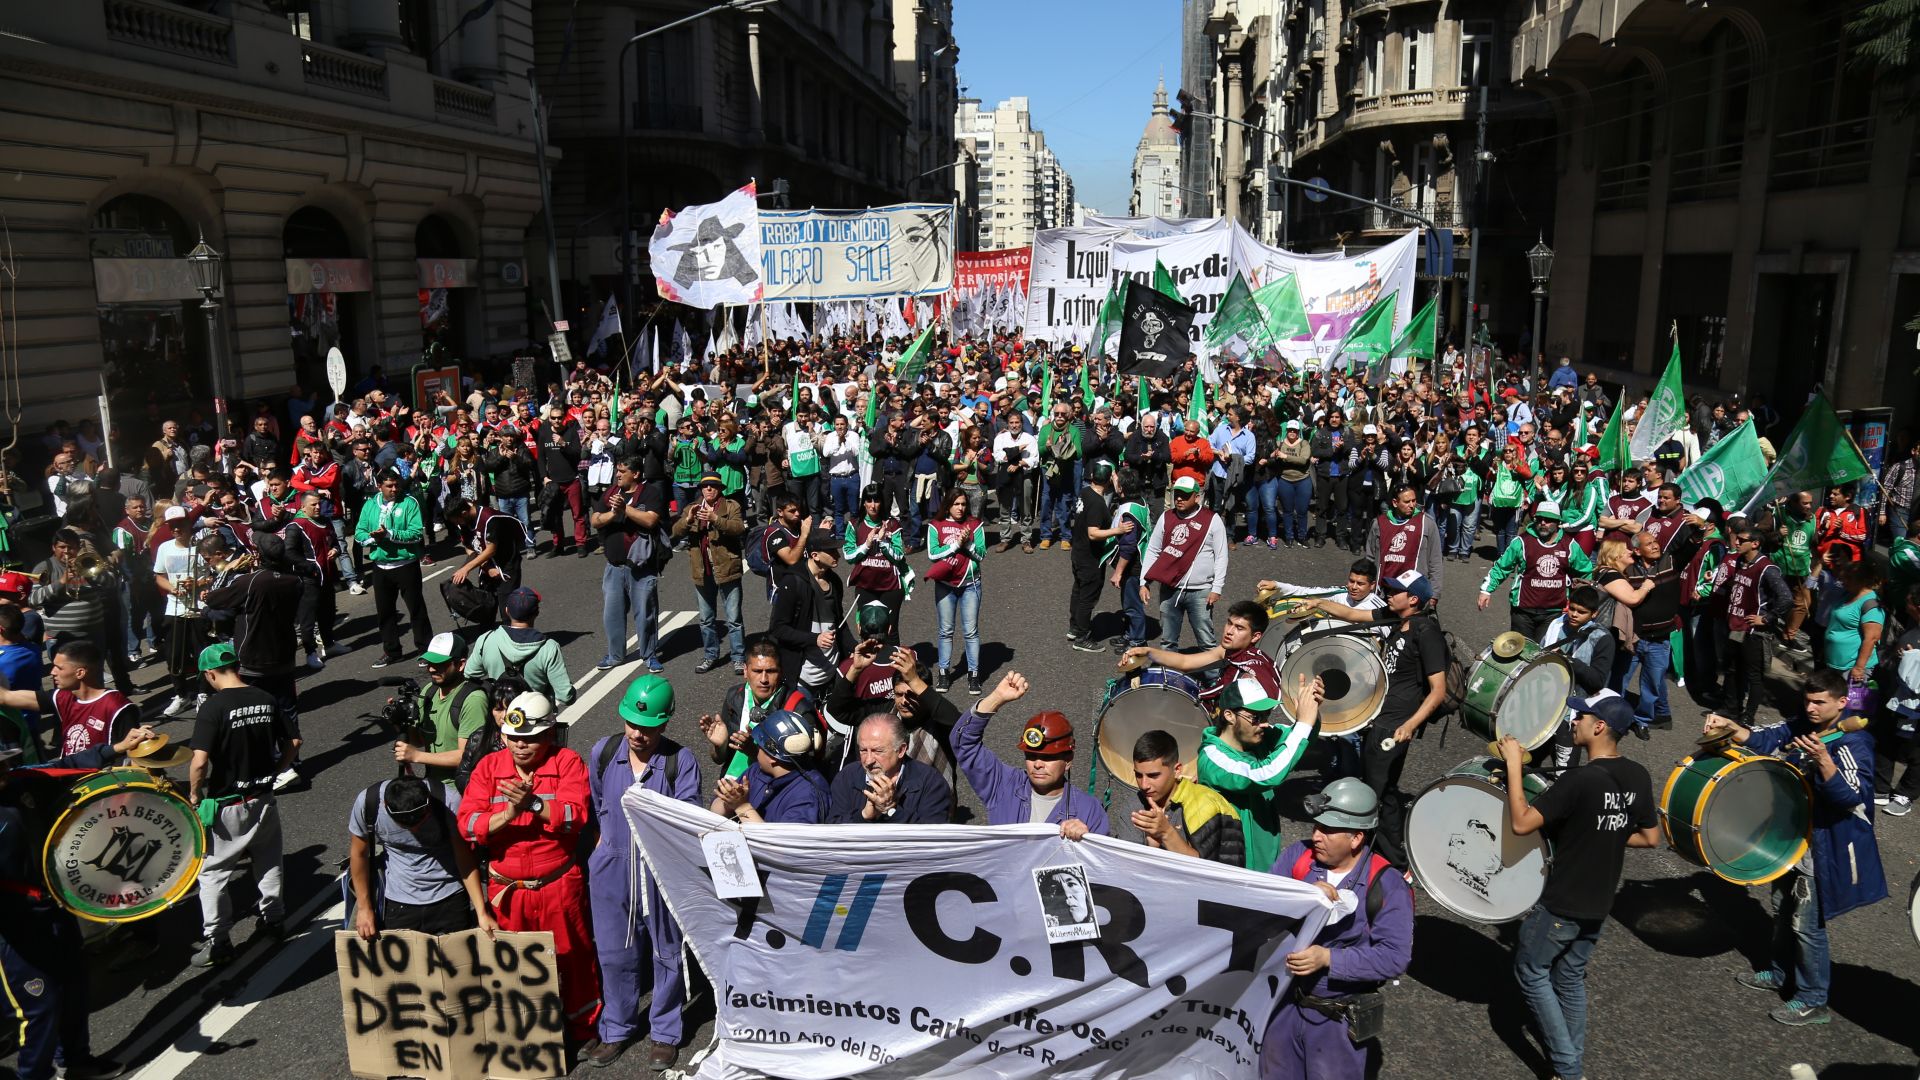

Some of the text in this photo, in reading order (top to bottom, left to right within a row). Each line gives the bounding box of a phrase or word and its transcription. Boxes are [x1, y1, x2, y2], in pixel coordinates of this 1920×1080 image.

[760, 217, 890, 245] TRABAJO Y DIGNIDAD
[760, 244, 892, 286] MILAGRO SALA
[956, 254, 1030, 269] OVIMIENTO
[1530, 578, 1563, 588] ORGANIZACION
[229, 704, 275, 720] FERREYR
[107, 805, 183, 846] LA BESTIA
[346, 933, 551, 987] NO A LOS
[392, 1038, 444, 1073] EN
[840, 1036, 867, 1058] del
[1161, 1023, 1189, 1035] de
